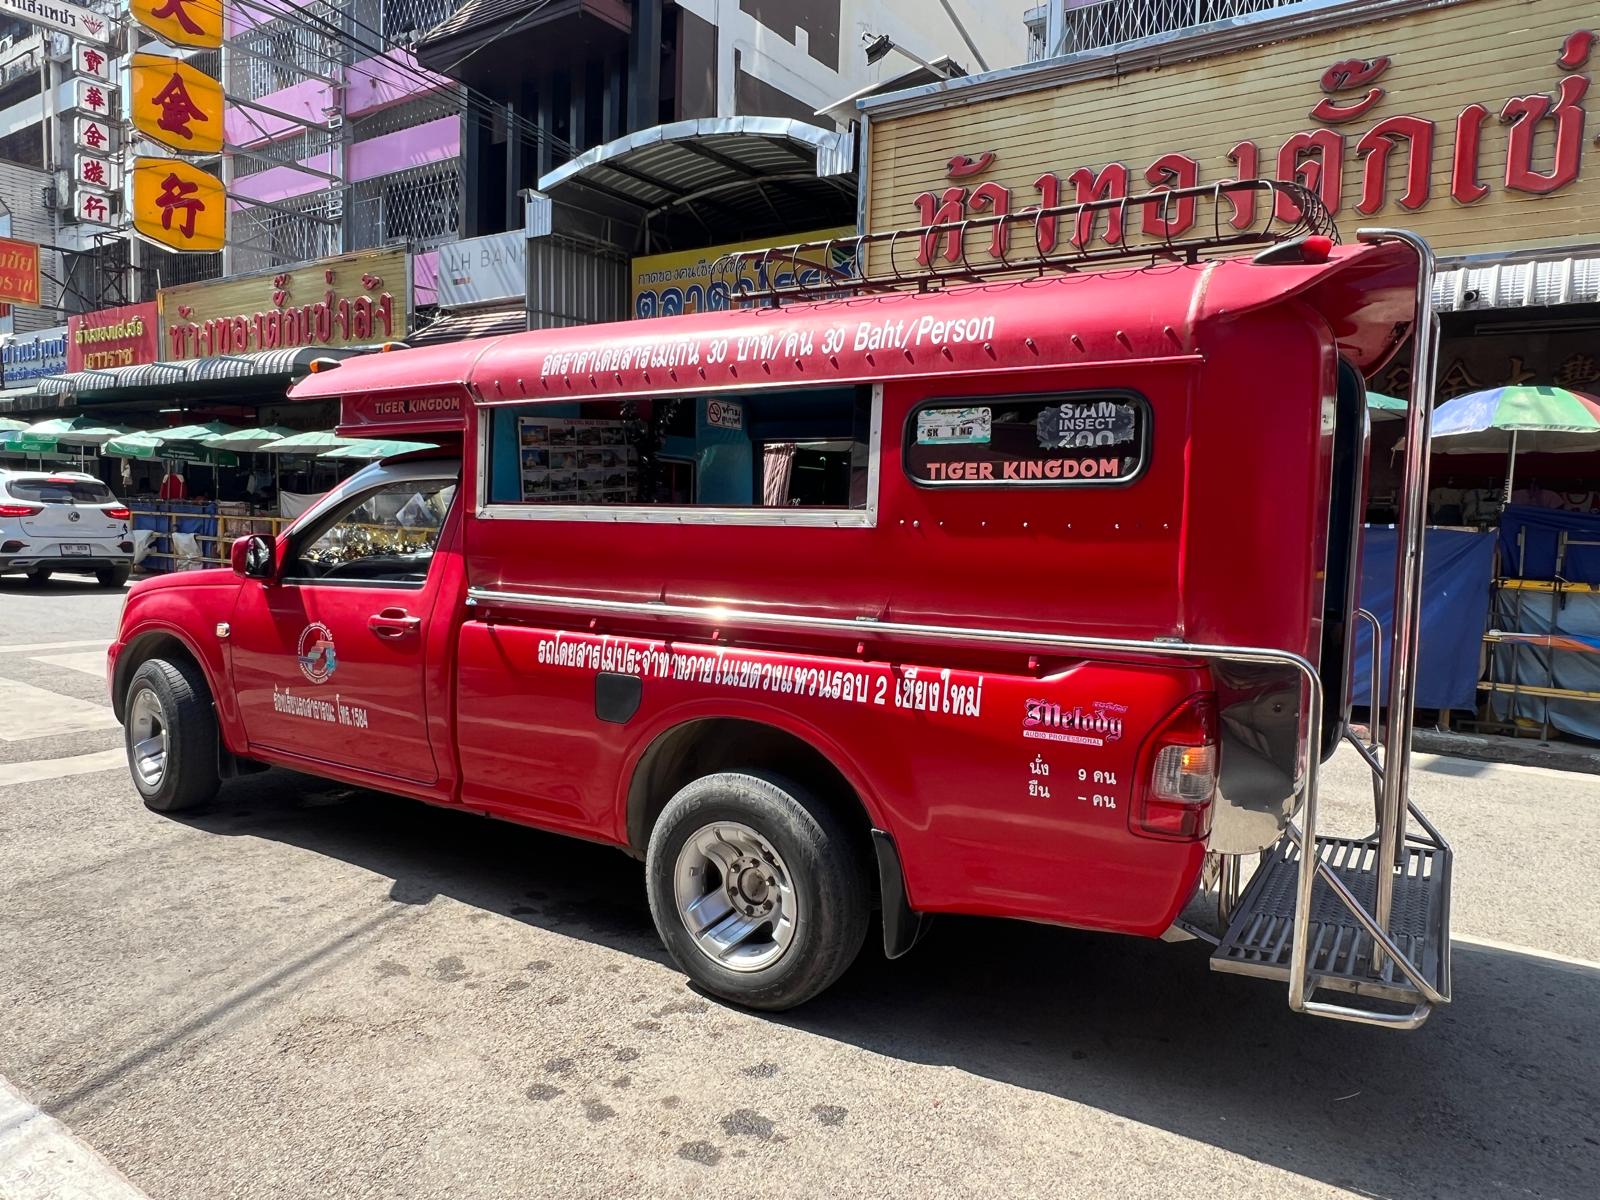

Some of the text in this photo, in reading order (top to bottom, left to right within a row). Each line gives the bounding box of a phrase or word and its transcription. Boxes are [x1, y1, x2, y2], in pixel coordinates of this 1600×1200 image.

[913, 29, 1599, 265] ห้างทองตั๊กเซ่
[450, 251, 471, 273] LH
[706, 338, 728, 364] 30
[821, 327, 846, 354] 30
[853, 315, 995, 351] Baht/Person
[375, 397, 460, 414] TIGER KINGDOM
[1059, 401, 1116, 419] SIAM
[1058, 418, 1116, 430] INSECT
[1058, 430, 1115, 448] ZOO
[927, 458, 1119, 480] TIGER KINGDOM
[874, 675, 888, 705] 2
[895, 667, 984, 717] เชียงใหม่
[1023, 698, 1122, 742] Melody
[1024, 731, 1101, 746] AUDIO PROFESSIONAL
[1029, 753, 1117, 785] นั่ง 9 คน
[1028, 779, 1050, 798] ยืน
[1093, 794, 1117, 809] คน
